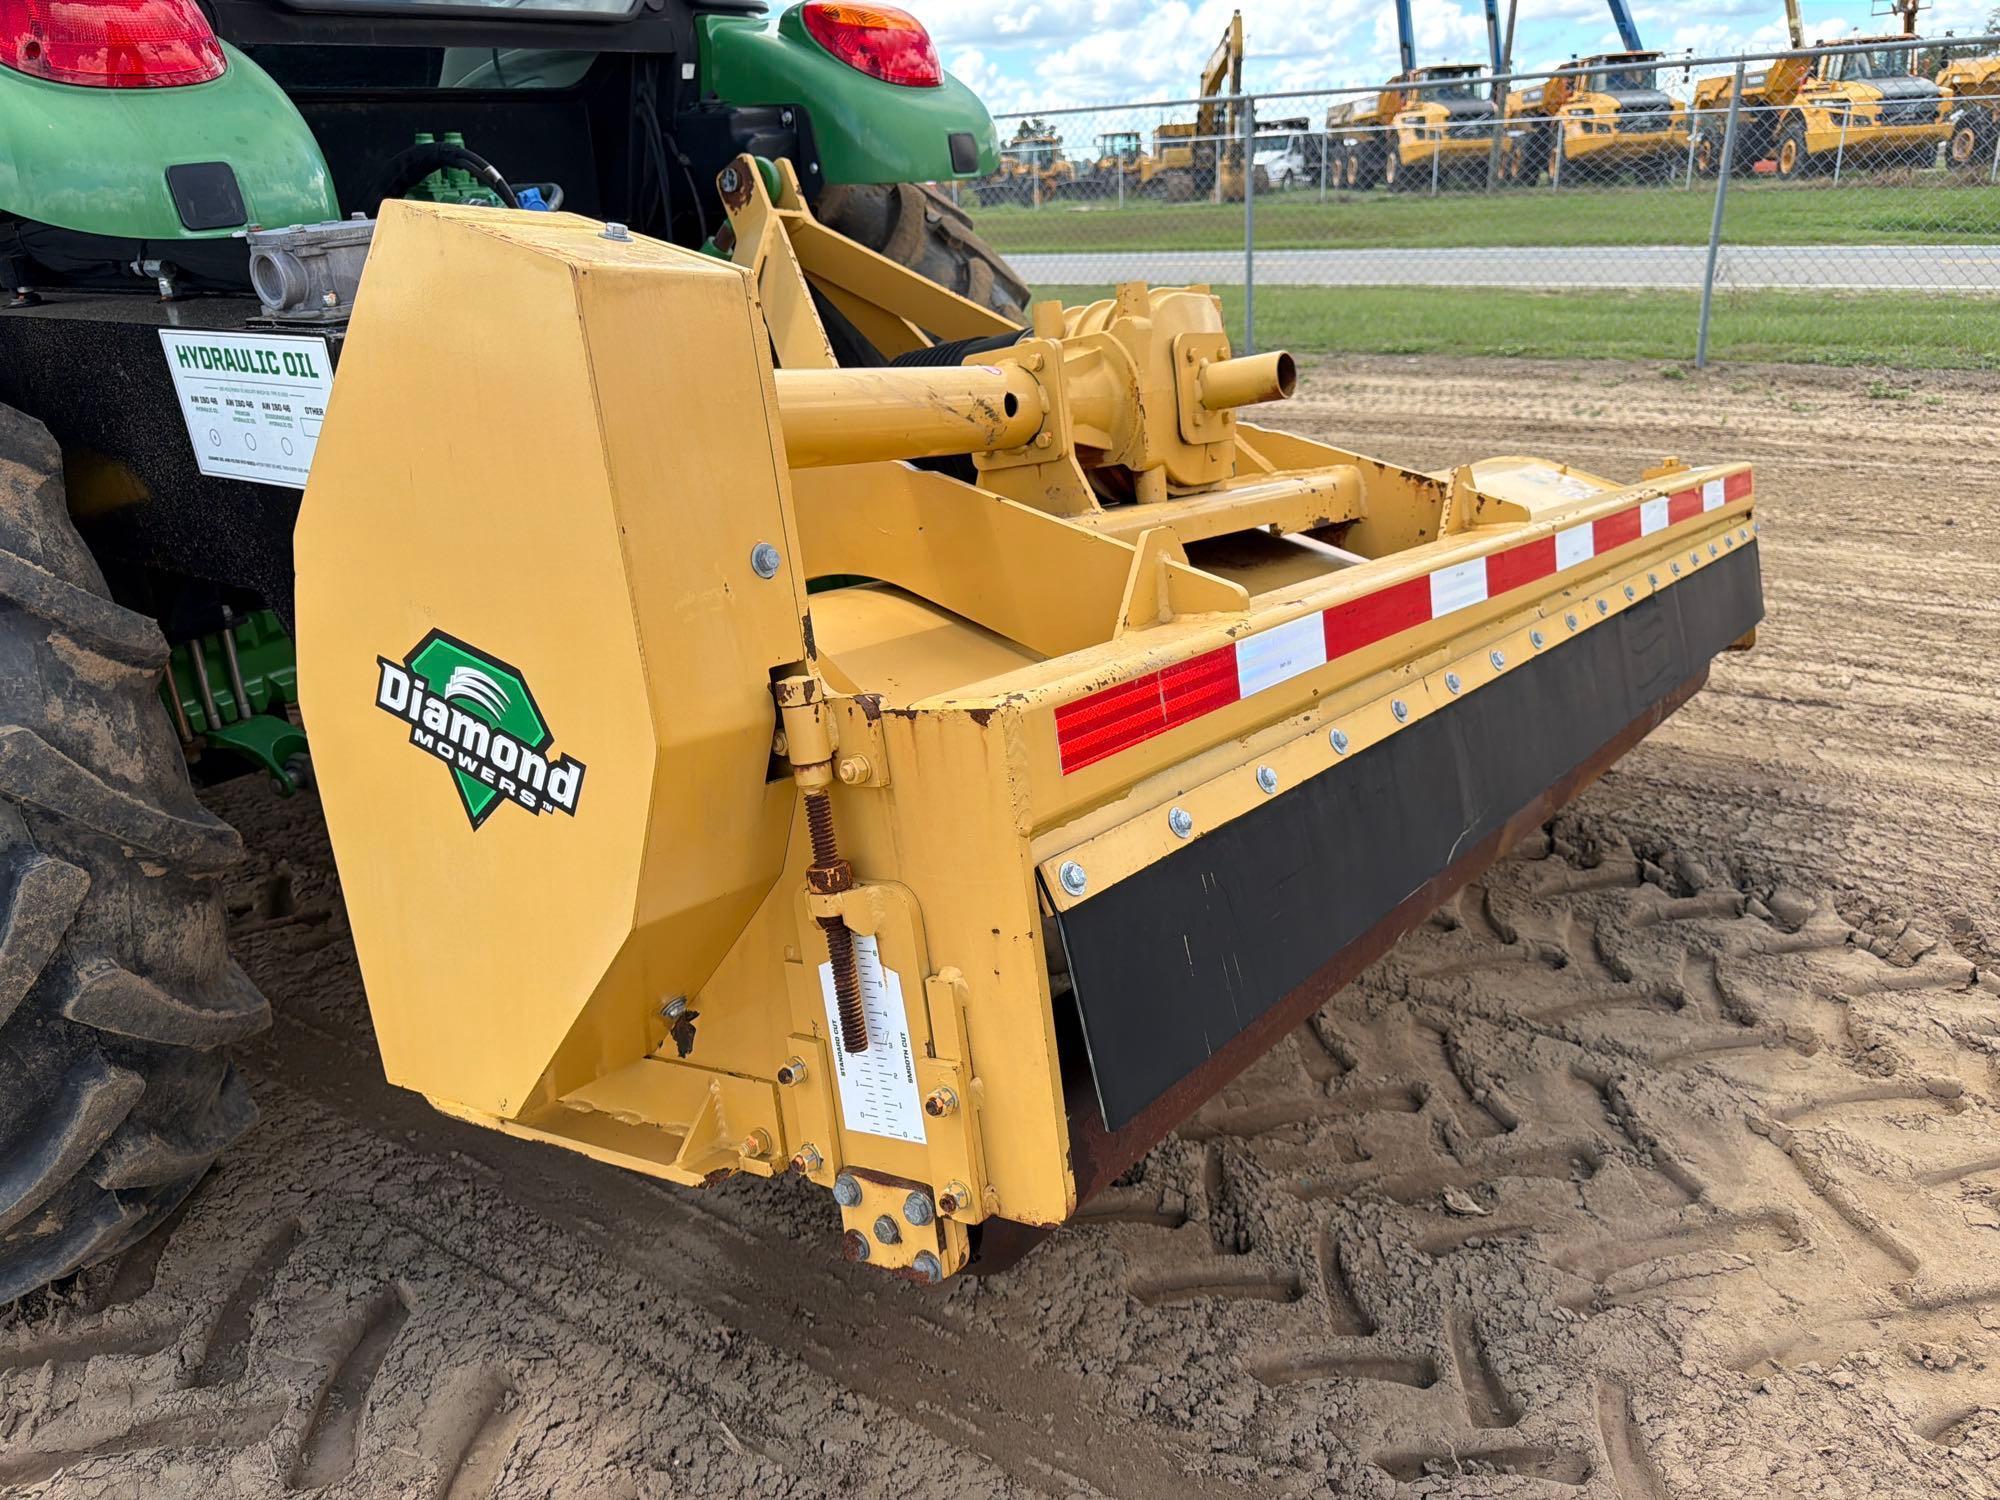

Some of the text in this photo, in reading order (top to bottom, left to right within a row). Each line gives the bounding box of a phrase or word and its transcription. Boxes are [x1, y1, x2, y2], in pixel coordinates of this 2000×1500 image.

[176, 344, 320, 378] HYDRAULIC OIL
[304, 406, 324, 416] OTHER
[379, 662, 580, 809] Diamond
[414, 728, 538, 808] MOWERS
[835, 1036, 846, 1077] STANDARD
[903, 1050, 913, 1084] SMOOTH
